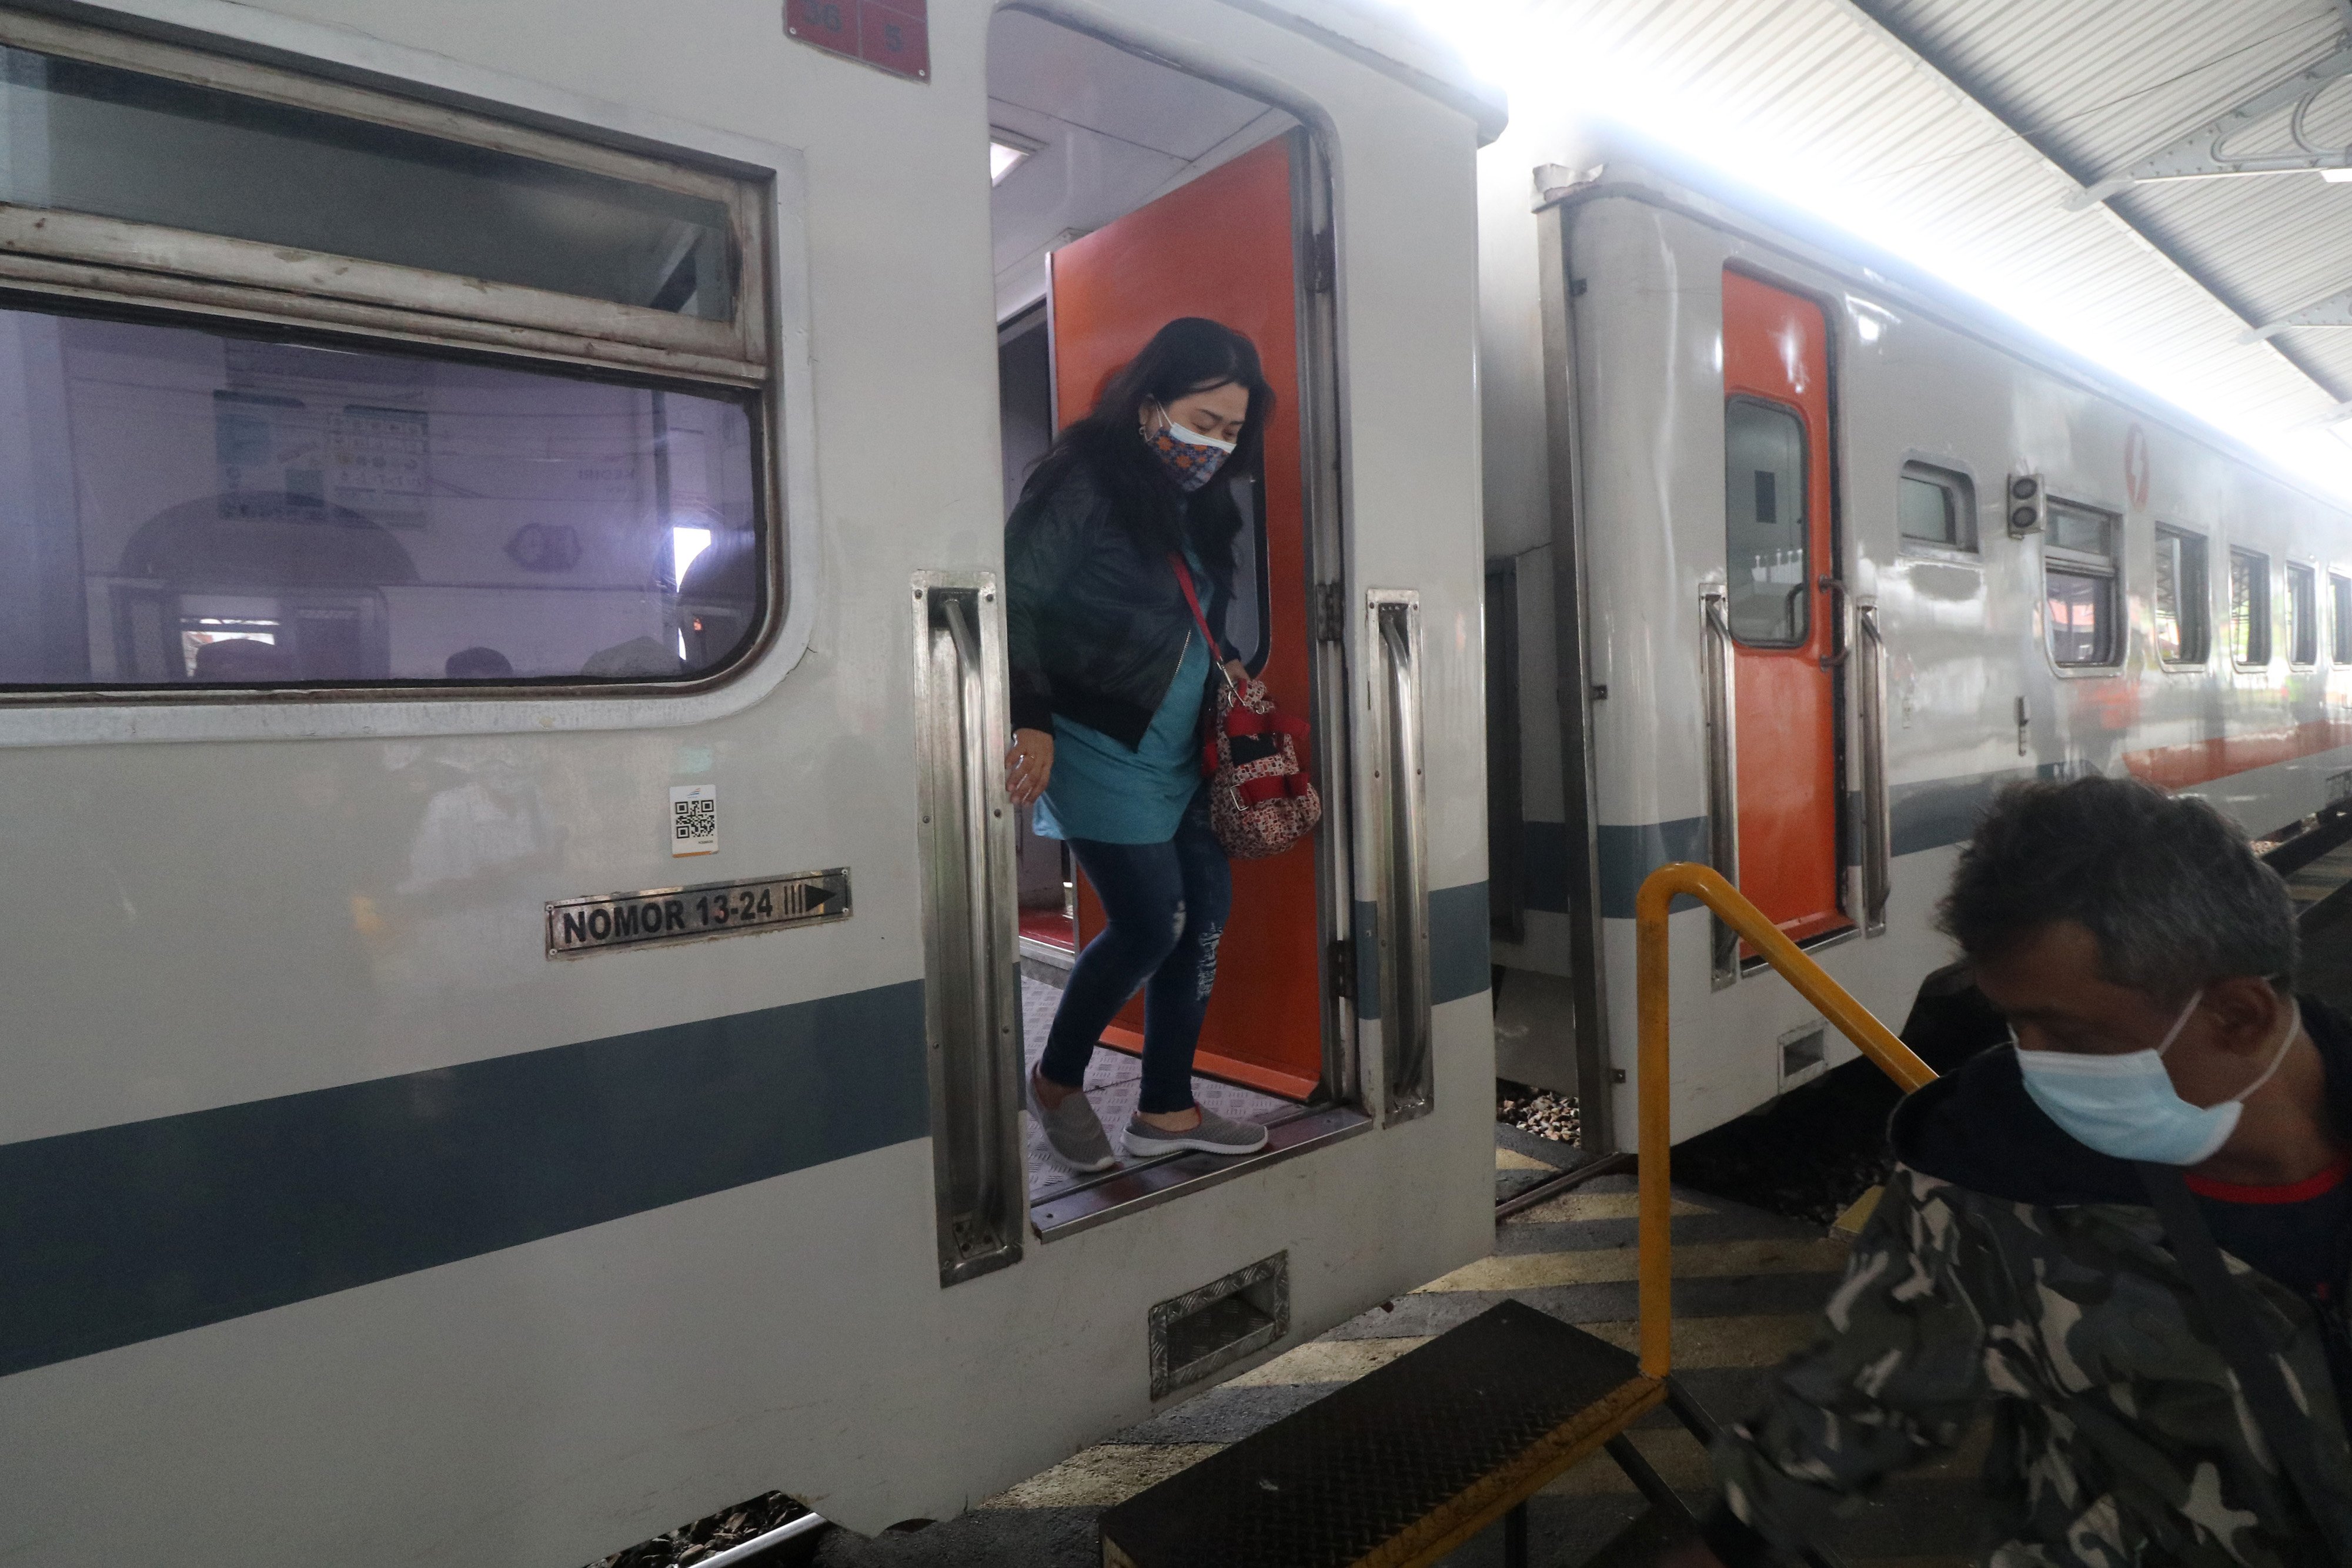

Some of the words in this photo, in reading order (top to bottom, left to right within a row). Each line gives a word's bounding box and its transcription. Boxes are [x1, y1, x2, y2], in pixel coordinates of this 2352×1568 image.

[885, 24, 901, 52] 5
[563, 900, 686, 944] NOMOR
[696, 888, 773, 925] 13-24
